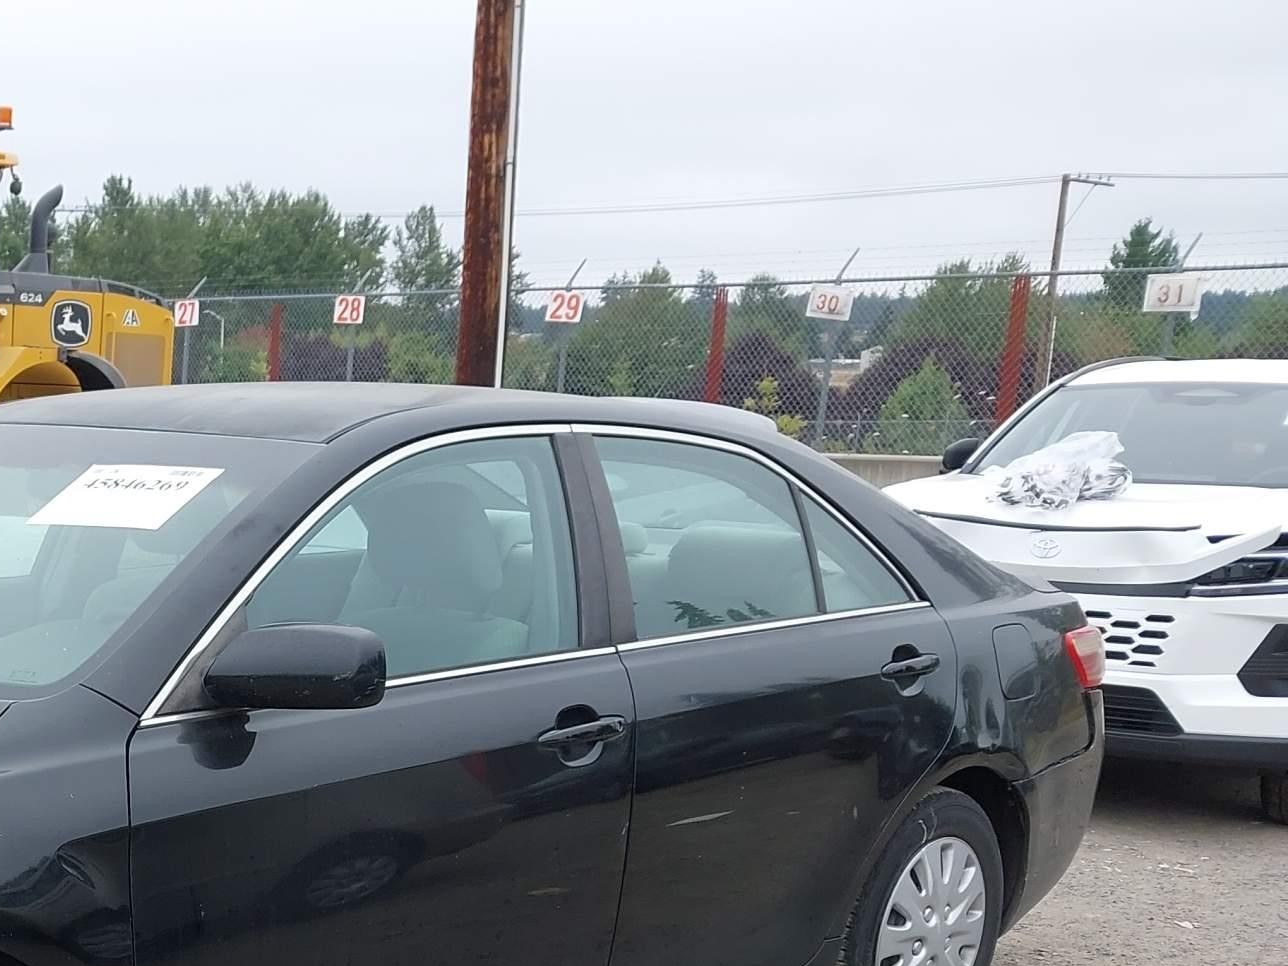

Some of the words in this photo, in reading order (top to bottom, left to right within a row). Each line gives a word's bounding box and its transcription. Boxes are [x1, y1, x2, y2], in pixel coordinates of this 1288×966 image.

[20, 292, 43, 303] 624
[816, 294, 840, 312] 30
[1158, 284, 1184, 304] 31
[178, 302, 195, 324] 27
[337, 297, 361, 321] 28
[550, 293, 580, 320] 29
[83, 478, 190, 491] 45846269
